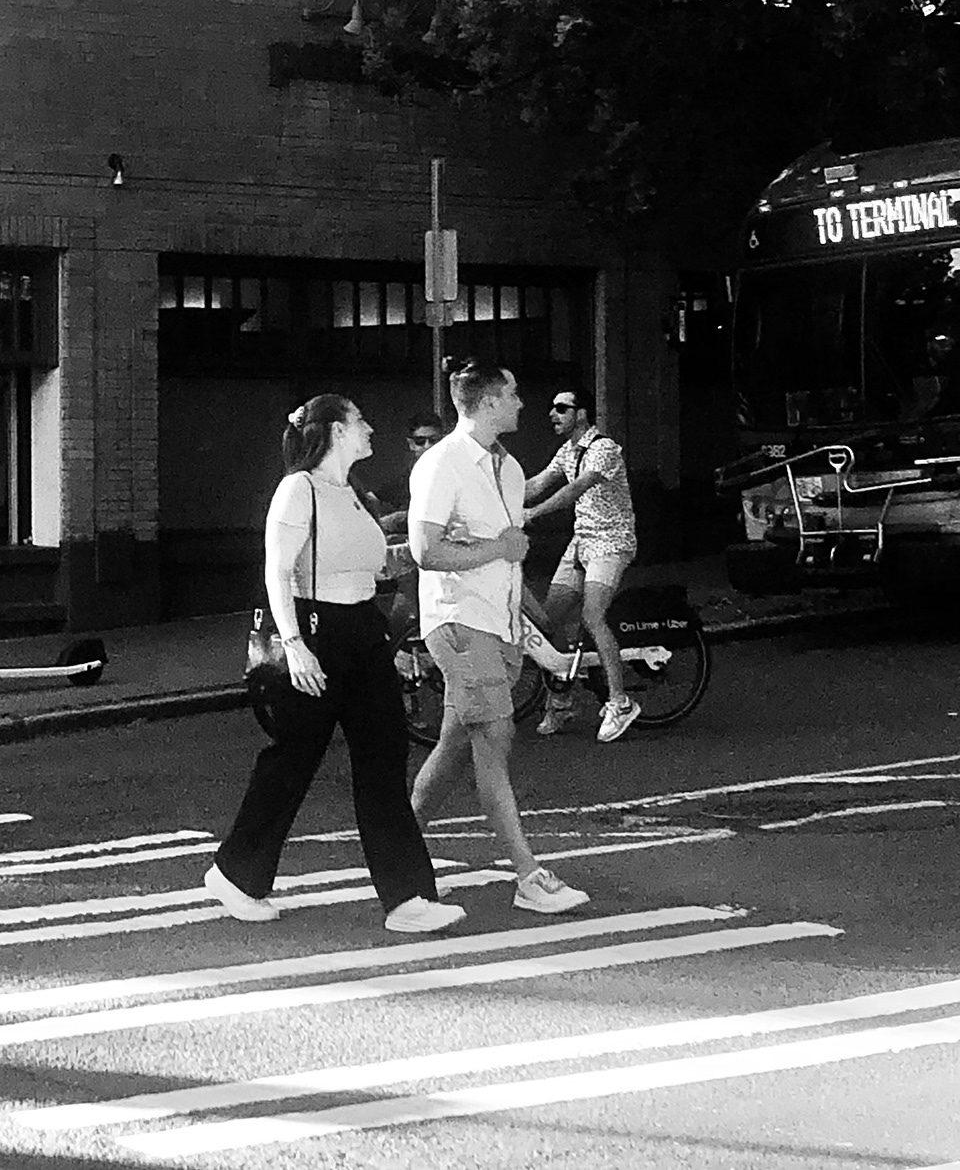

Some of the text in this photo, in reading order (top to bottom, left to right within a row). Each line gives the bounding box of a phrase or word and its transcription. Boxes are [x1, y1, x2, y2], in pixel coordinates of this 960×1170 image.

[813, 190, 958, 244] TO TERMINAL
[619, 621, 636, 632] On
